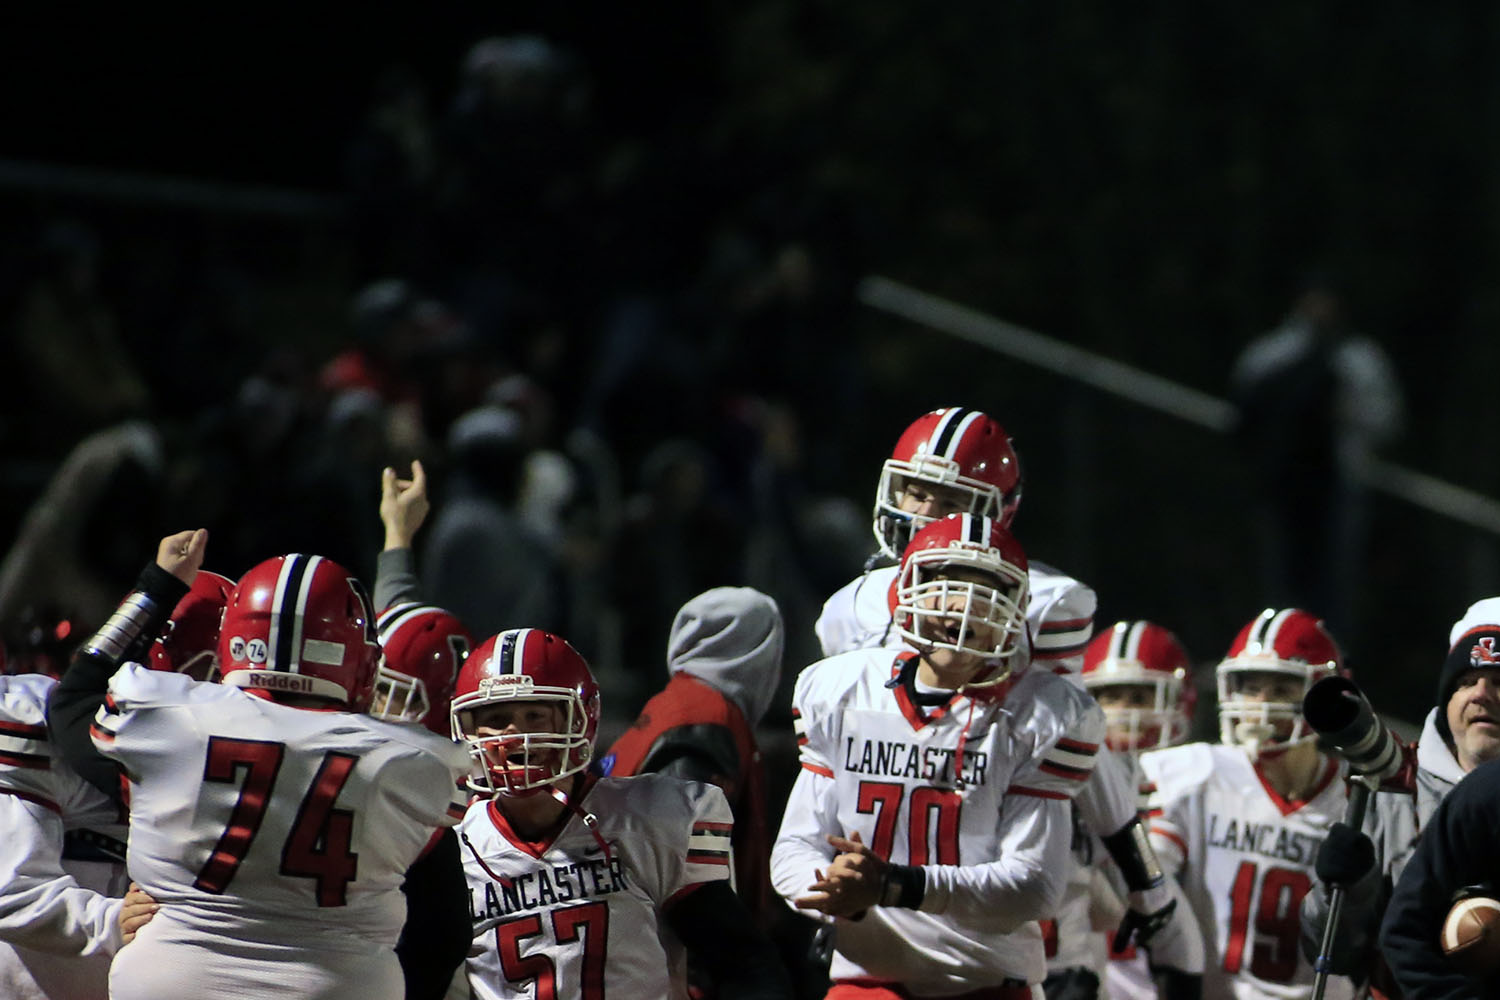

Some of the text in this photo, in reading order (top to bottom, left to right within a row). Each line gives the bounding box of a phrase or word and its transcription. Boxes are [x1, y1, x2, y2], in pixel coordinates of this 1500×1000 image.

[249, 643, 265, 658] 74
[249, 673, 313, 693] Riddell
[845, 736, 987, 786] LANCASTER
[193, 735, 360, 908] 74
[856, 780, 963, 867] 70
[469, 857, 629, 921] LANCASTER
[1224, 860, 1312, 983] 19
